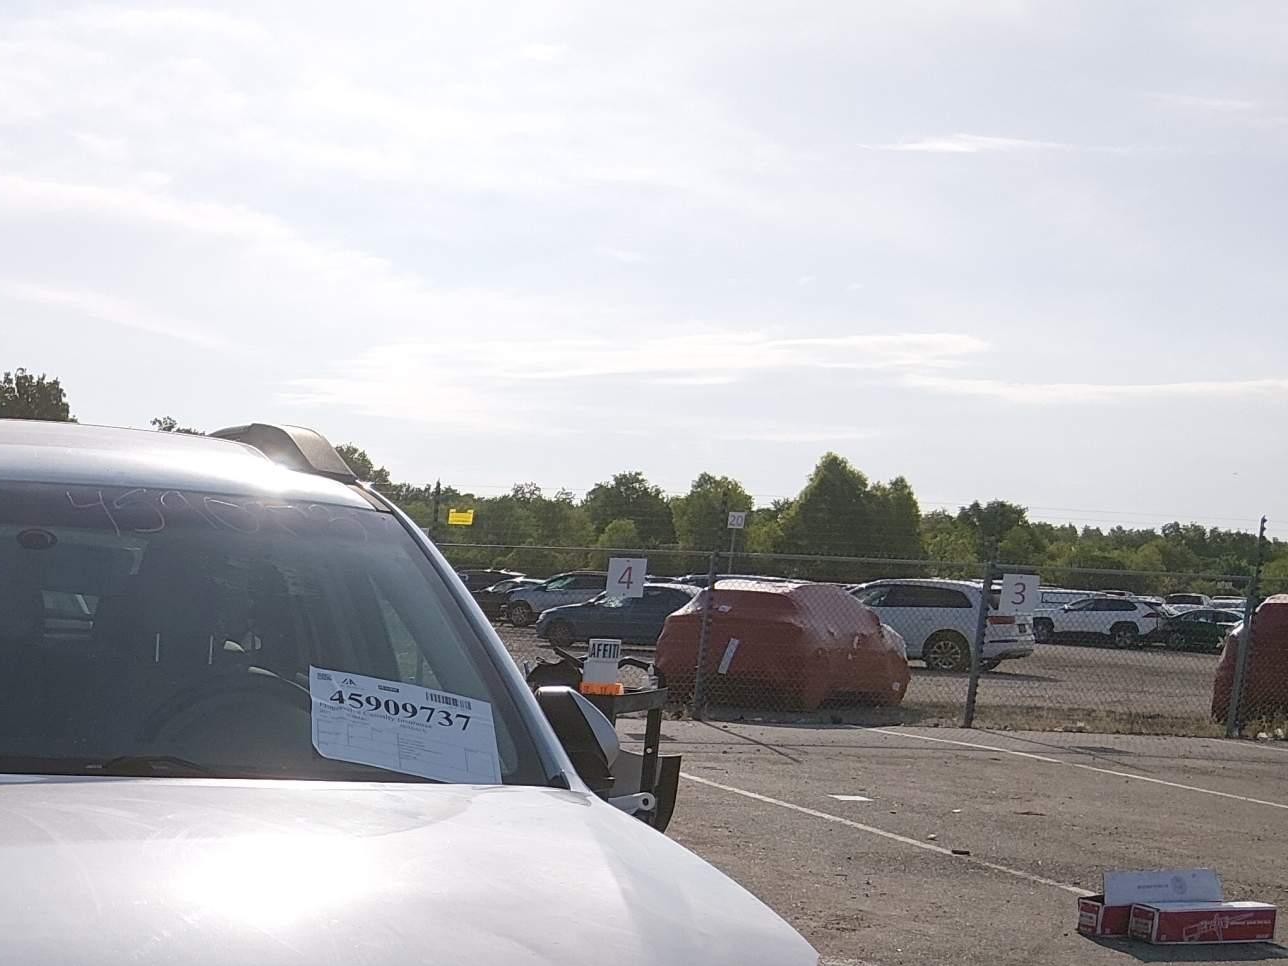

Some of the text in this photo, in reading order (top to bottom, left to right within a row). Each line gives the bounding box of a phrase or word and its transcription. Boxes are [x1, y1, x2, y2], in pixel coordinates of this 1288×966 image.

[729, 514, 744, 527] 20
[617, 566, 633, 590] 4
[1010, 582, 1026, 605] 3
[330, 689, 471, 731] 45909737
